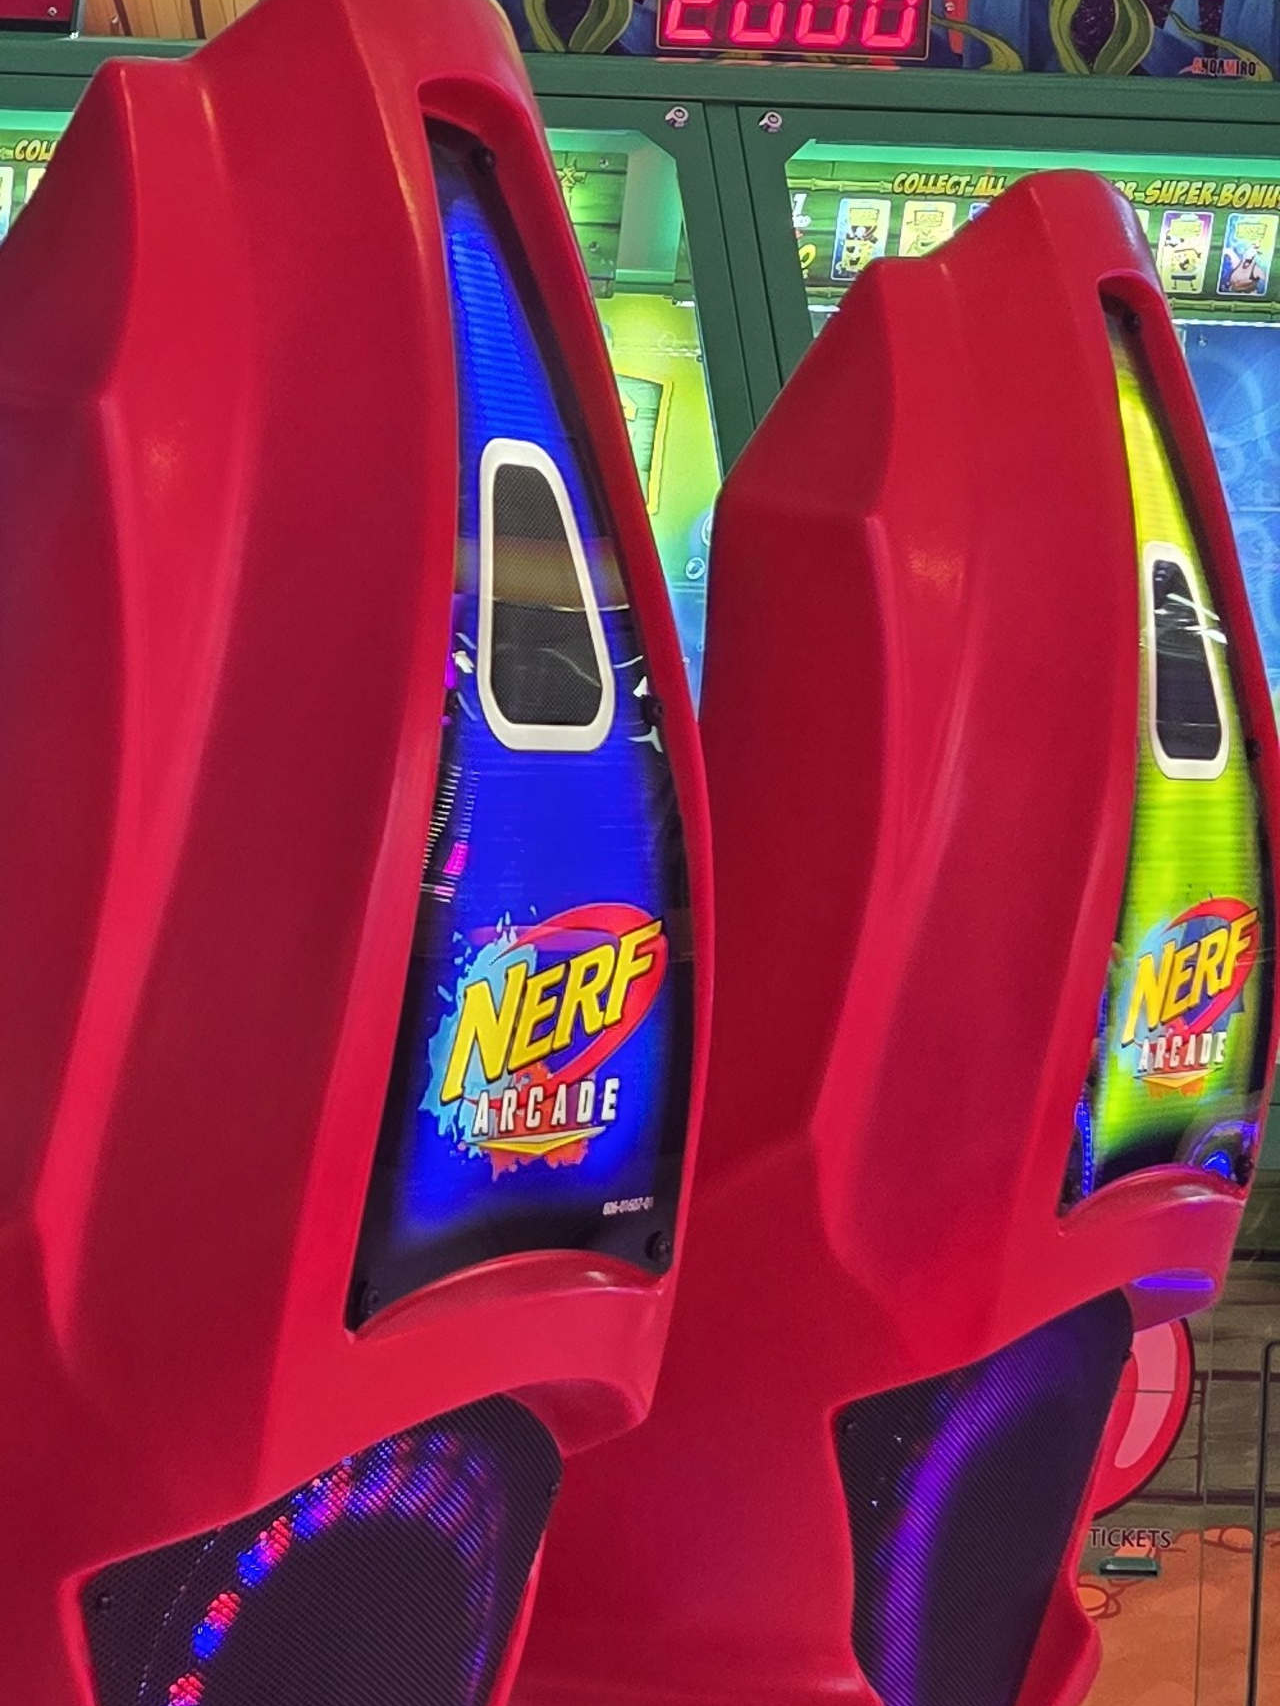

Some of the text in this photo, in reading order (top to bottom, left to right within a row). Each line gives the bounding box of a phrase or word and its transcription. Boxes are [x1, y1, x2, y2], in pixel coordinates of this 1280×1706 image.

[893, 172, 971, 197] COLLECT
[1143, 180, 1217, 206] SUPER
[1217, 182, 1280, 209] BONU
[1121, 907, 1260, 1049] NERF
[440, 917, 664, 1105] NERF
[1137, 1031, 1228, 1073] ARCADE
[472, 1077, 620, 1136] ARCADE
[1088, 1527, 1172, 1549] TICKETS
